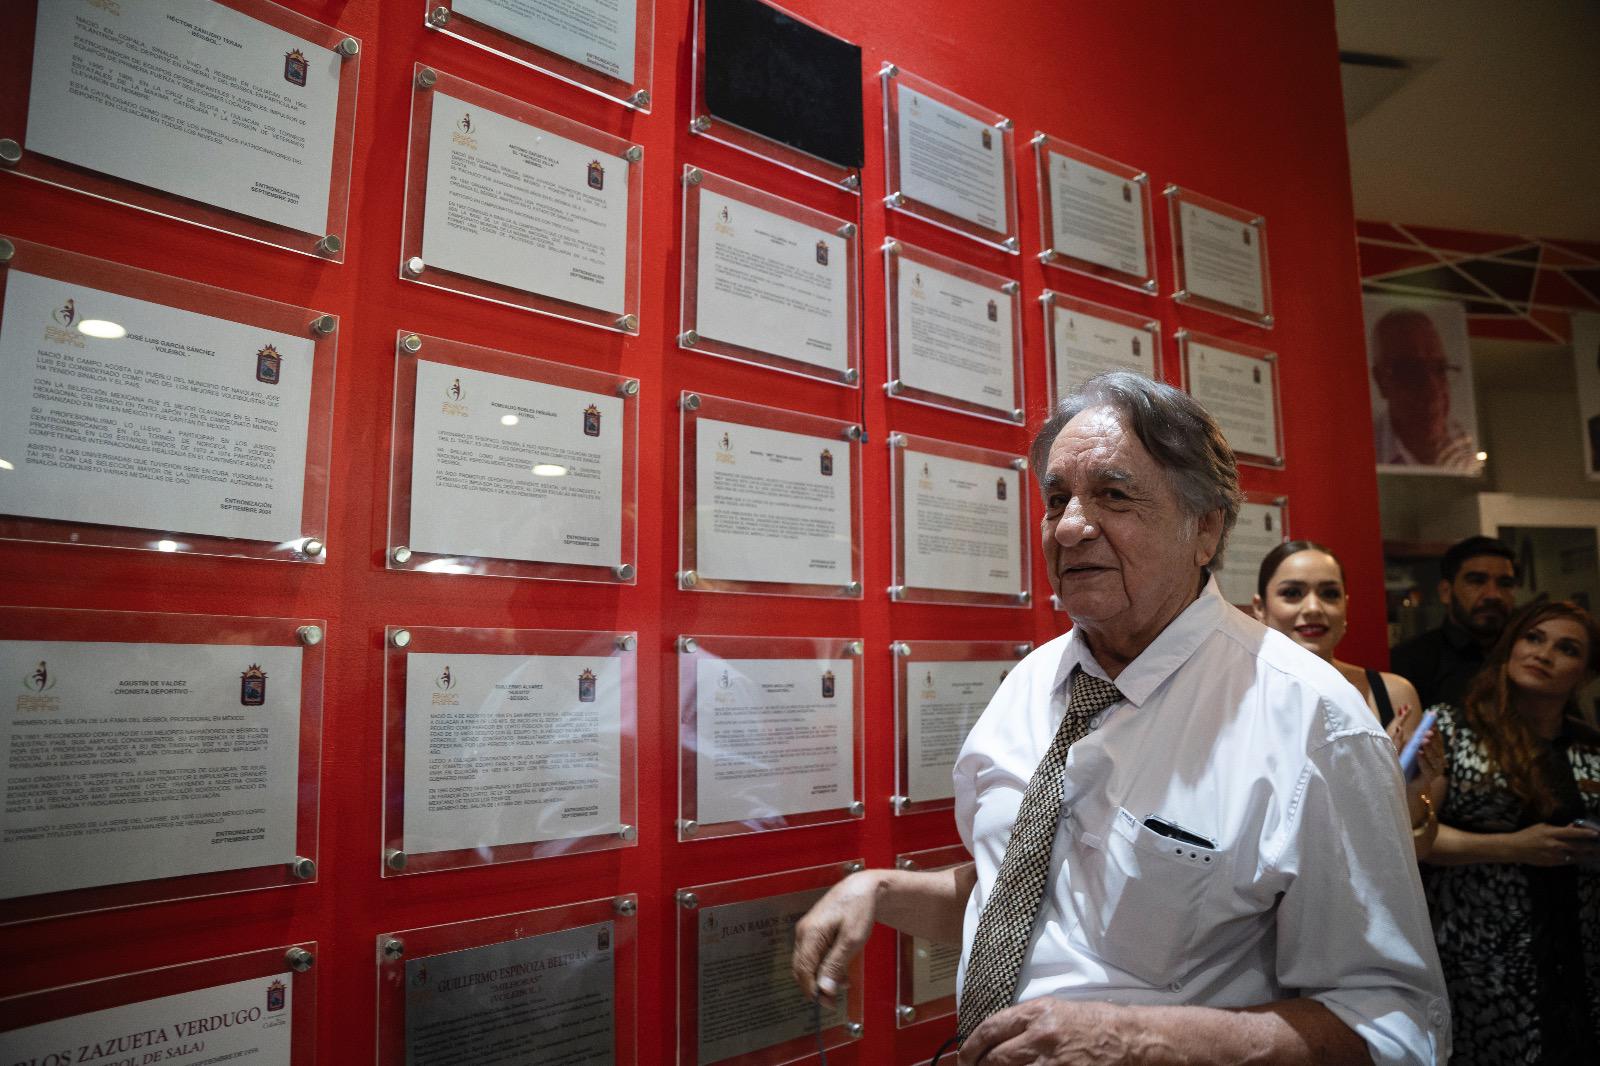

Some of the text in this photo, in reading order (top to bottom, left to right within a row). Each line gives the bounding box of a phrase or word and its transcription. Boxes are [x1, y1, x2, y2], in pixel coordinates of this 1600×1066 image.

[219, 503, 256, 512] SEPTIEMBRE
[438, 970, 496, 992] GUILLERMO
[499, 960, 545, 979] ESPINOZA
[78, 1028, 168, 1062] ZAZUETA
[174, 1006, 262, 1045] VERDUGO
[142, 1052, 162, 1065] DE
[166, 1042, 205, 1060] SALA)
